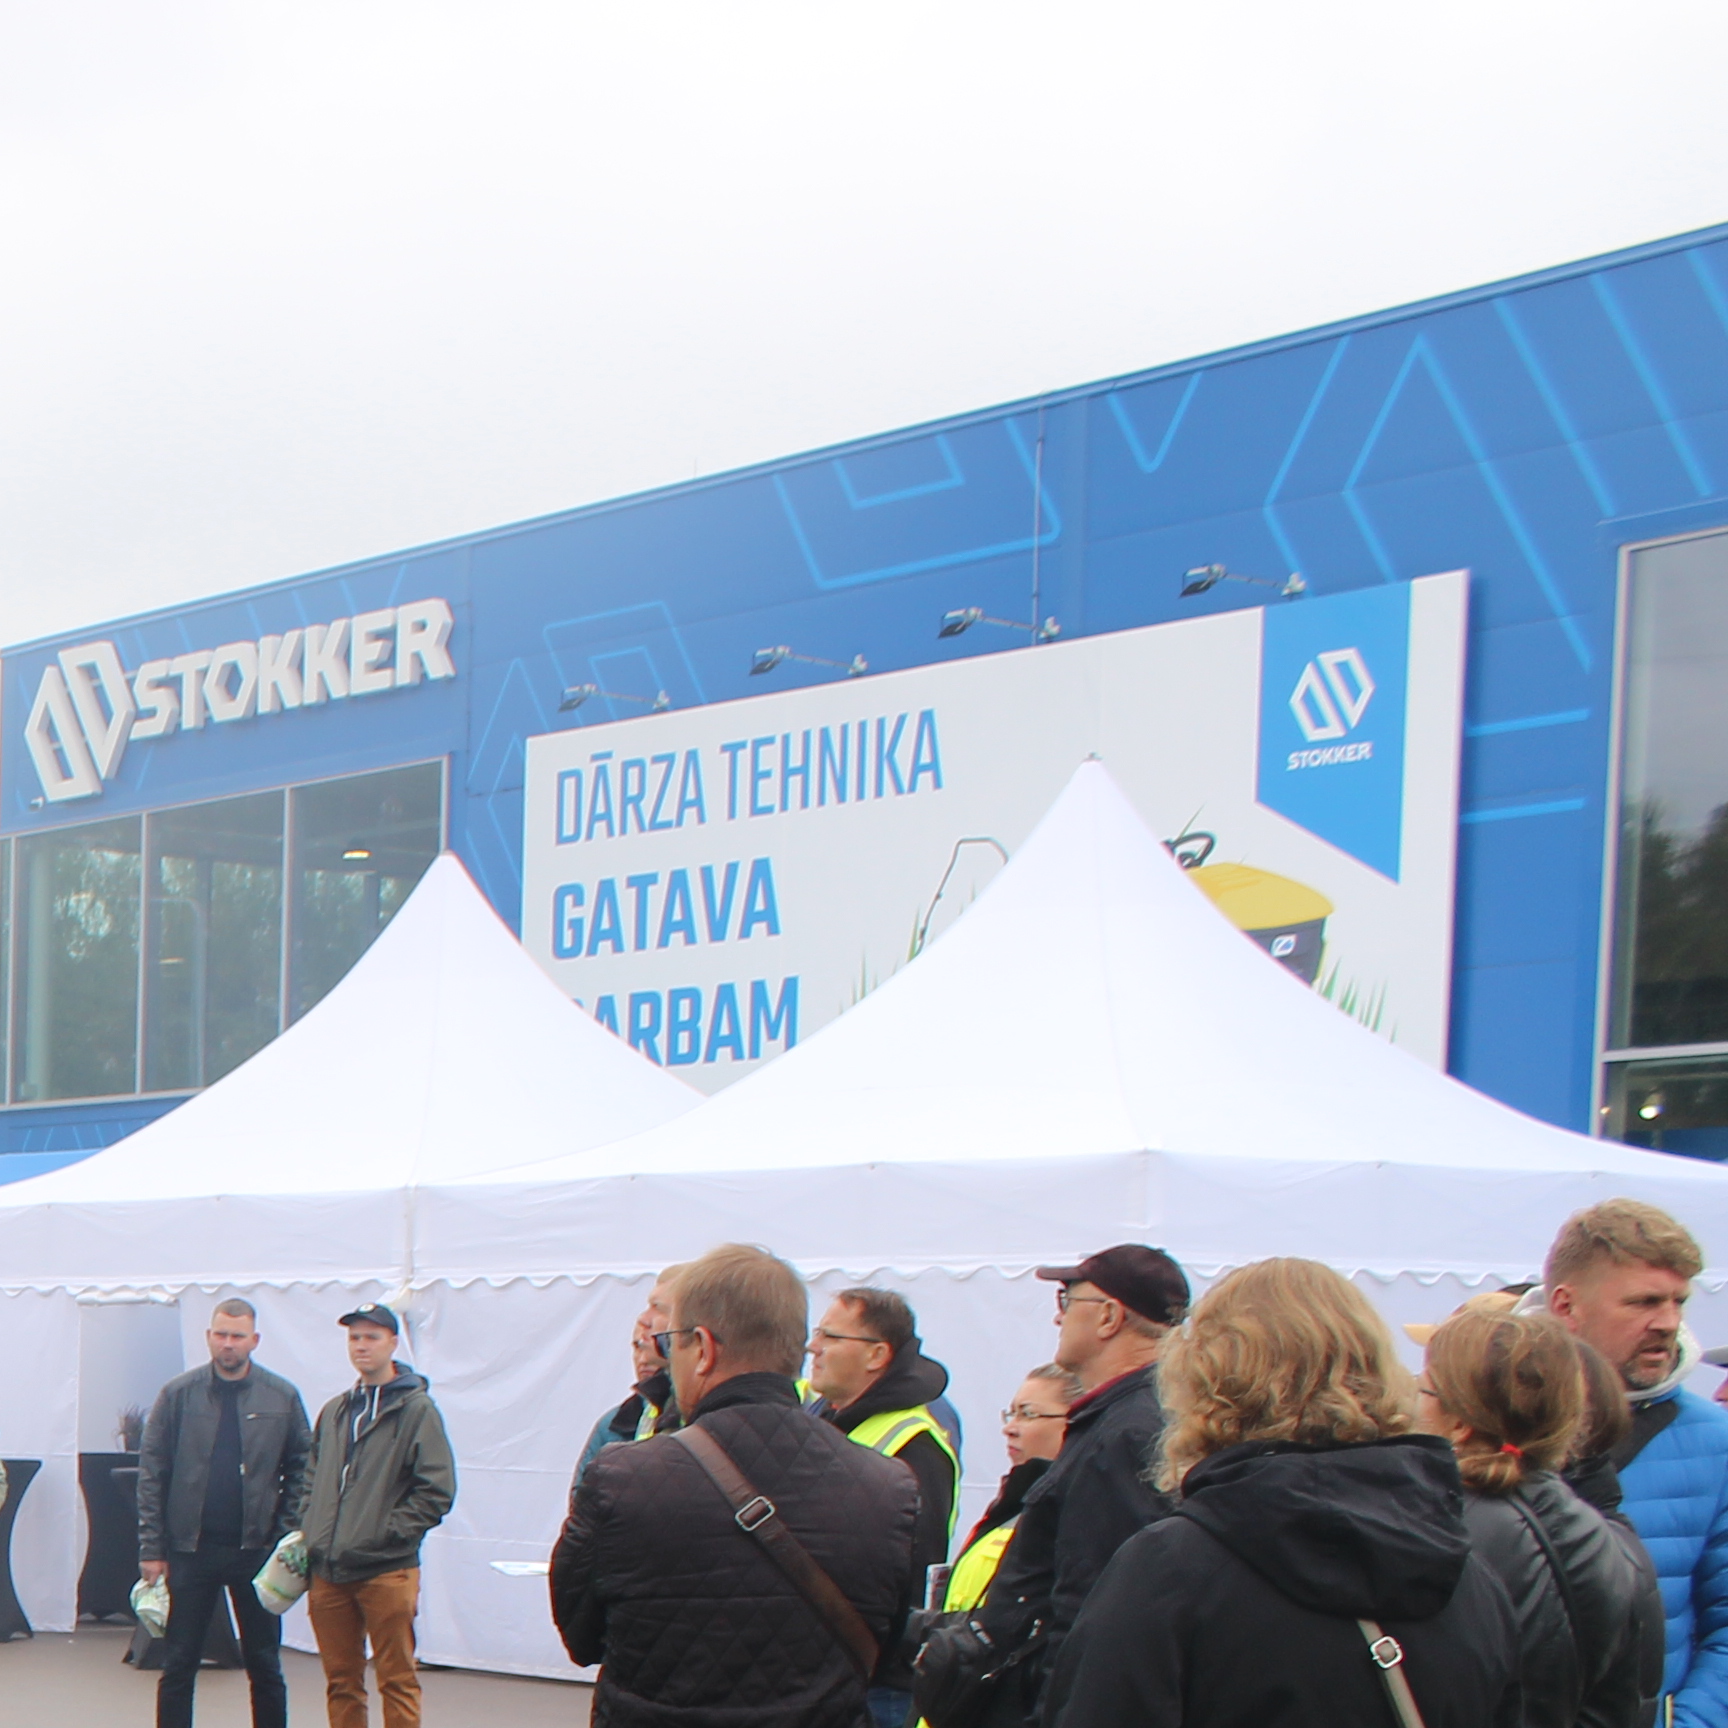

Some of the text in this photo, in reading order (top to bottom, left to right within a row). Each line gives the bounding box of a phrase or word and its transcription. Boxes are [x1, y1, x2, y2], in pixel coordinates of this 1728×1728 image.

[128, 597, 455, 741] STOKKER
[555, 708, 944, 846] DĀRZA TEHNIKA
[1286, 741, 1373, 771] STOKKER
[551, 856, 782, 960] GATAVA
[571, 975, 801, 1068] RBAM
